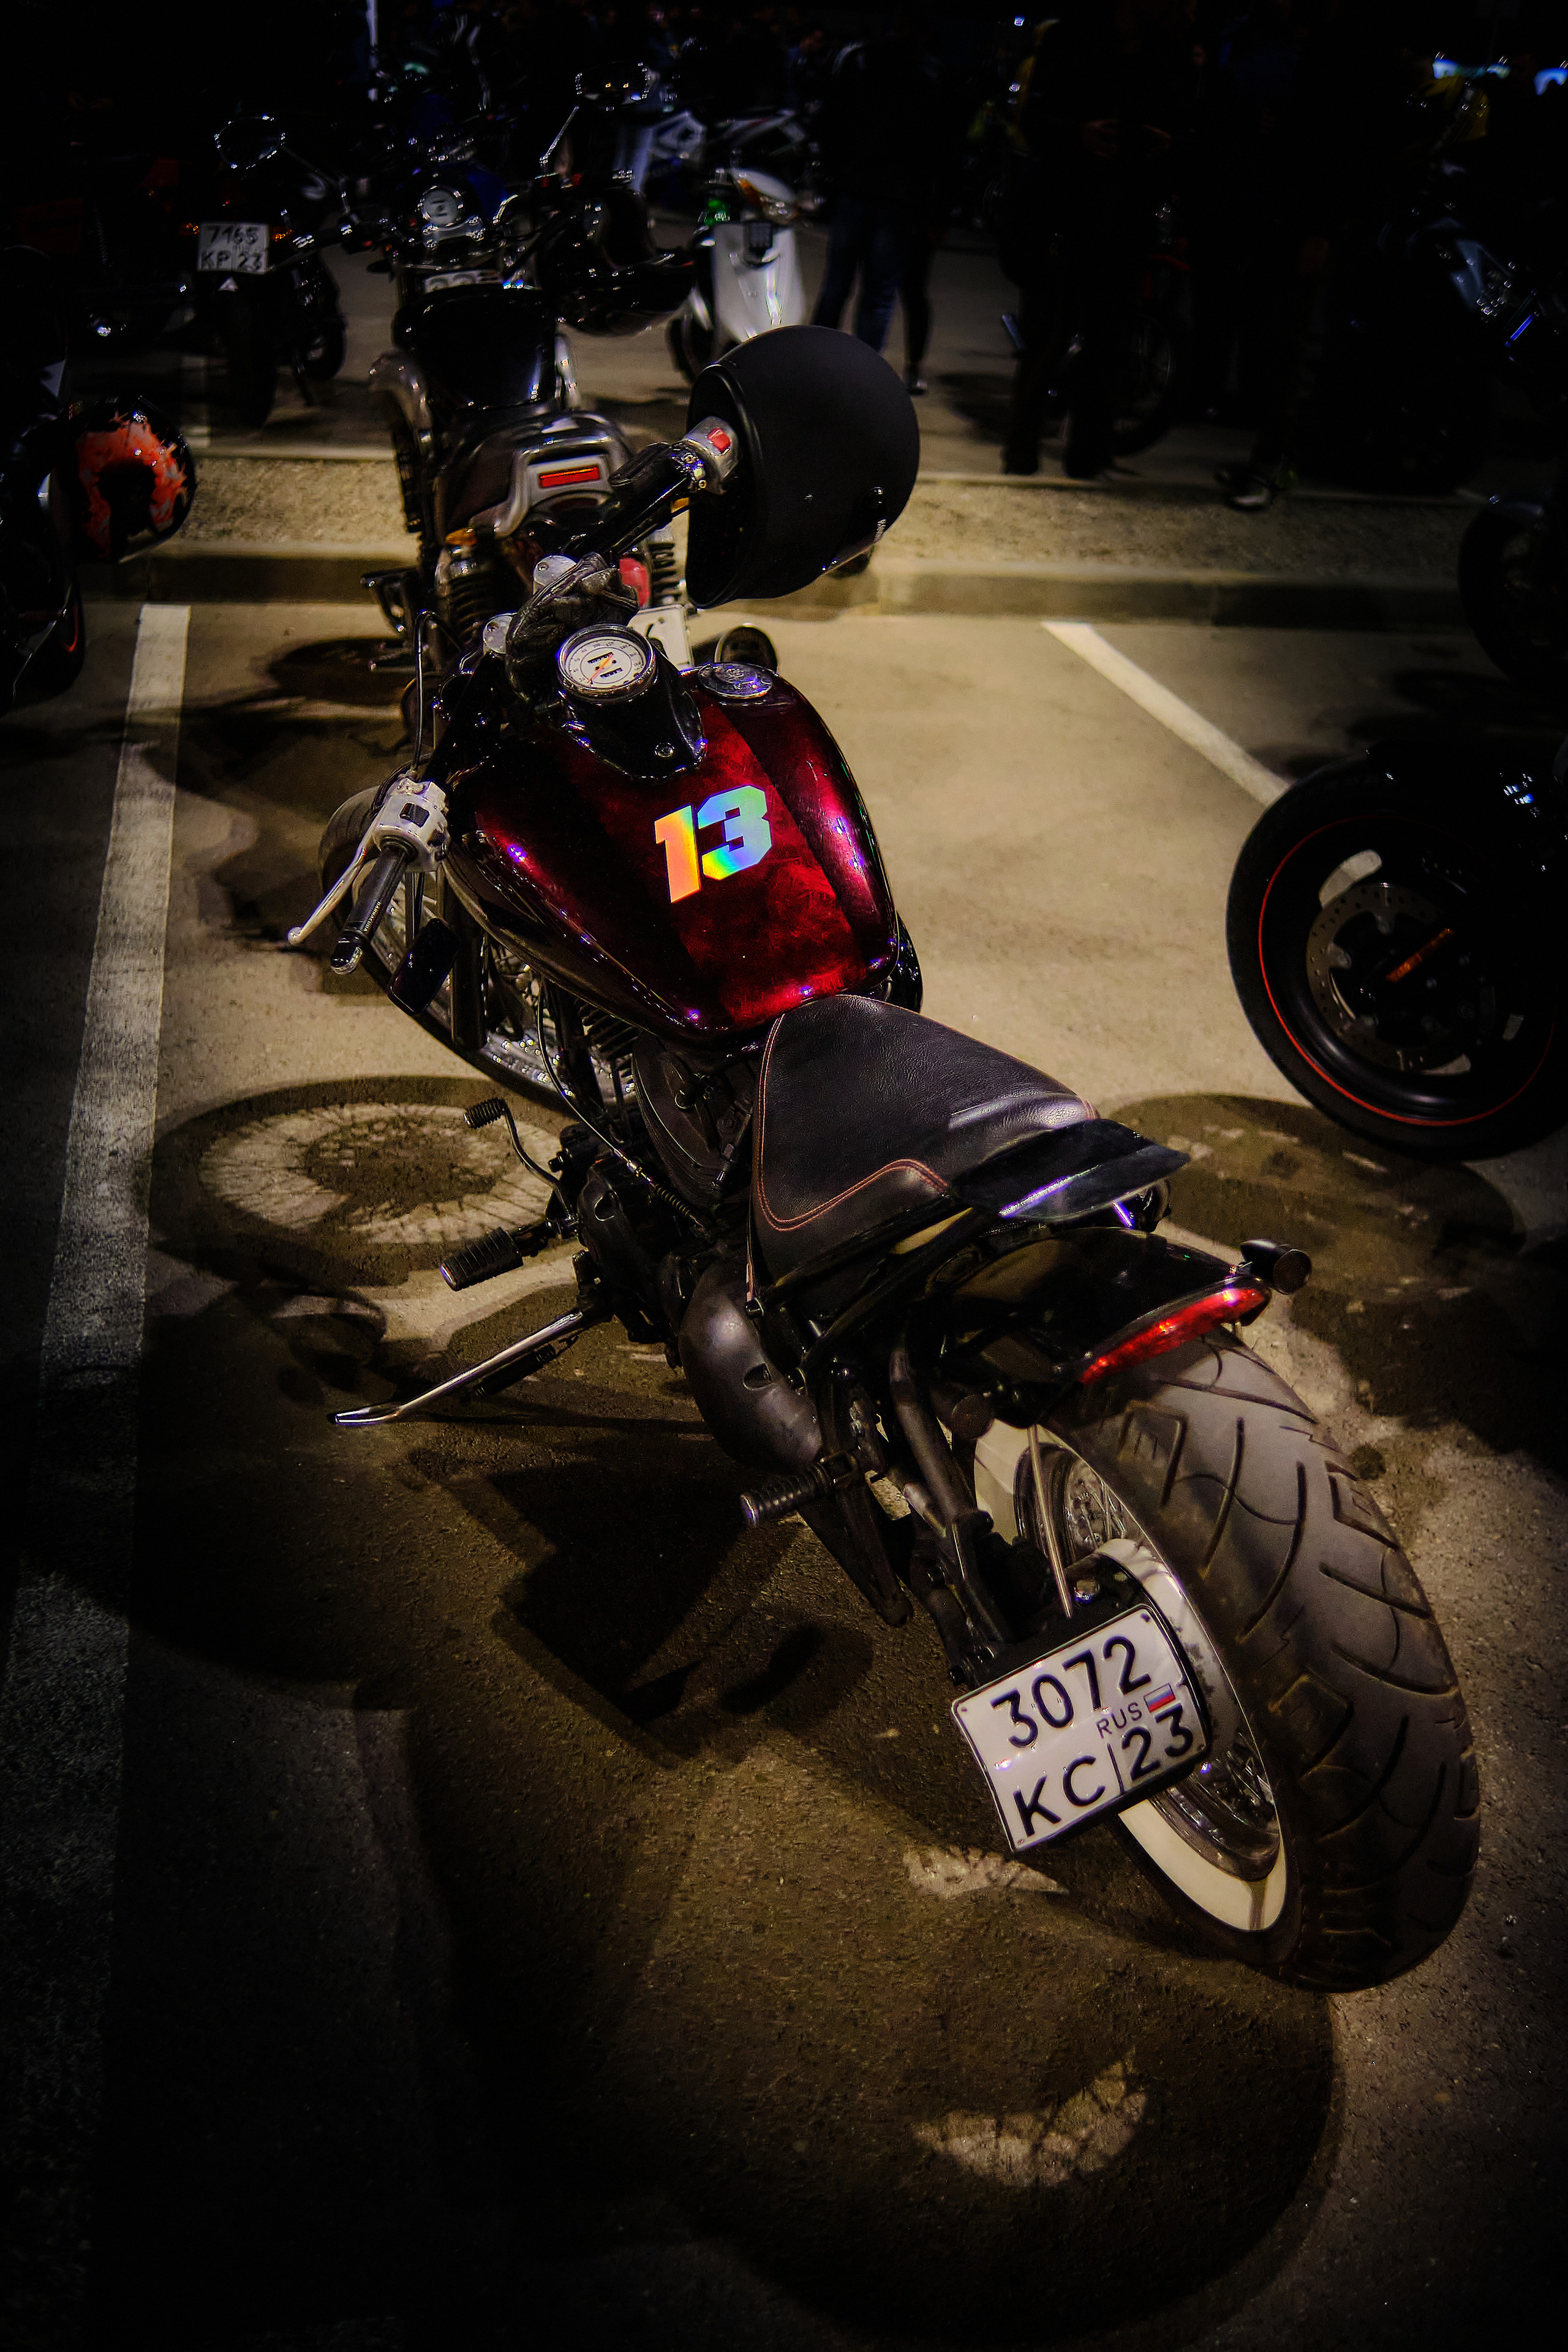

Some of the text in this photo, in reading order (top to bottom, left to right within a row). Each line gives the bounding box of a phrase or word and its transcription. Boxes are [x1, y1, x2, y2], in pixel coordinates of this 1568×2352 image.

[201, 250, 262, 271] KP 23
[206, 225, 259, 244] 7165
[654, 785, 772, 903] 13
[990, 1635, 1152, 1748] 3072
[1095, 1702, 1143, 1739] RUS
[1012, 1702, 1194, 1838] KC 23
